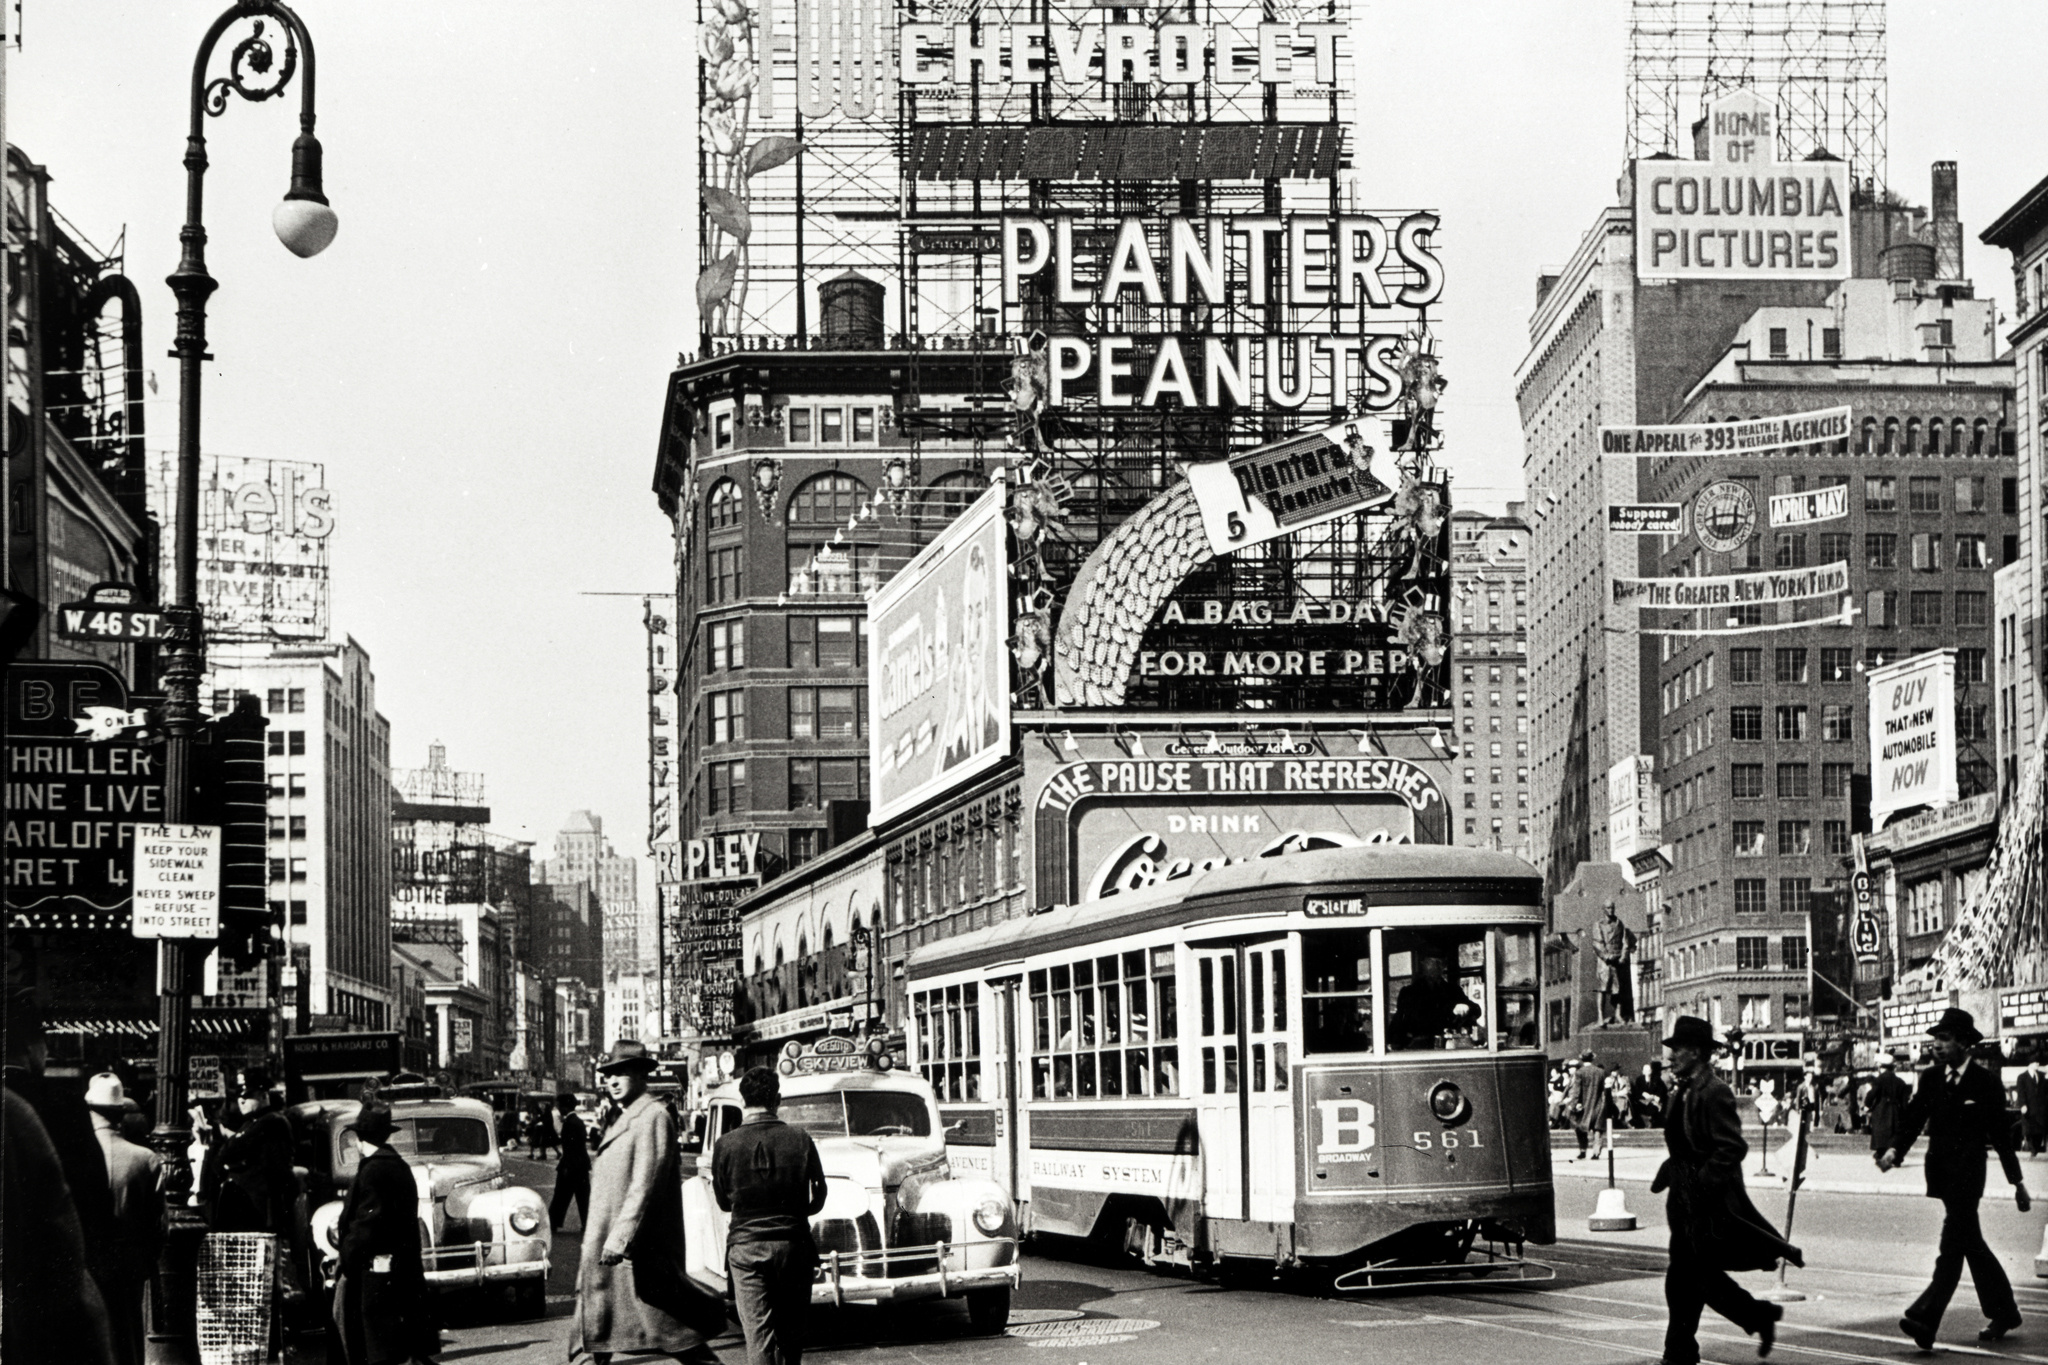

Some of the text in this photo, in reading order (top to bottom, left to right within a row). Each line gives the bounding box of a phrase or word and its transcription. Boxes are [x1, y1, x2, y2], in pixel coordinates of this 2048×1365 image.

[901, 22, 1348, 84] CHEVROLET
[1714, 111, 1771, 136] HOME
[1727, 140, 1755, 163] OF
[1650, 176, 1843, 217] COLUMBIA
[1002, 212, 1444, 309] PLANTERS
[1651, 228, 1839, 268] PICTURES
[1047, 336, 1405, 410] PEANUTS
[1603, 430, 1631, 453] ONE
[1635, 429, 1687, 452] APPEAL
[1705, 427, 1735, 450] 393
[1737, 422, 1771, 436] HEALTH
[1738, 434, 1779, 448] WELFARE
[1782, 415, 1848, 443] AGENCIES
[1619, 507, 1668, 520] Suppose
[1648, 582, 1671, 605] THE
[1675, 582, 1730, 605] GREATER
[1735, 579, 1764, 601] NEW
[1769, 576, 1808, 599] YORK
[1809, 570, 1845, 595] FUND
[64, 610, 86, 634] W.
[88, 611, 123, 636] 46
[130, 613, 162, 638] ST.
[1163, 600, 1396, 625] A BAG A DAY
[1140, 650, 1407, 675] FOR MORE PEP
[879, 633, 934, 720] Camels
[652, 614, 669, 788] RIPLEY
[1892, 676, 1928, 711] BUY
[104, 715, 135, 728] ONE
[1885, 707, 1935, 735] THAT NEW
[1882, 731, 1936, 761] AUTOMOBILE
[6, 746, 151, 775] HRILLER
[1039, 761, 1440, 812] THE PAUSE THAT REFRESHES
[1891, 758, 1929, 793] NOW
[84, 784, 161, 812] LIVE
[141, 826, 213, 839] THE LAW
[1167, 814, 1260, 834] DRINK
[143, 845, 209, 857] KEEP YOUR
[149, 858, 204, 869] SIDEWALK
[656, 832, 760, 884] RIPLEY
[108, 858, 129, 887] 4
[158, 872, 194, 882] CLEAN
[137, 889, 216, 901] NEVER SWEEP
[154, 903, 196, 913] REFUSE
[139, 916, 212, 927] INTO STREET
[1857, 877, 1873, 953] BOWLING
[803, 1055, 868, 1069] SKY-VIEW
[1316, 1099, 1375, 1153] B
[1414, 1129, 1484, 1150] 561
[951, 1156, 988, 1171] AVENUE
[1318, 1153, 1372, 1163] BROADWAY
[1033, 1161, 1162, 1184] RAILWAY SYSTEM
